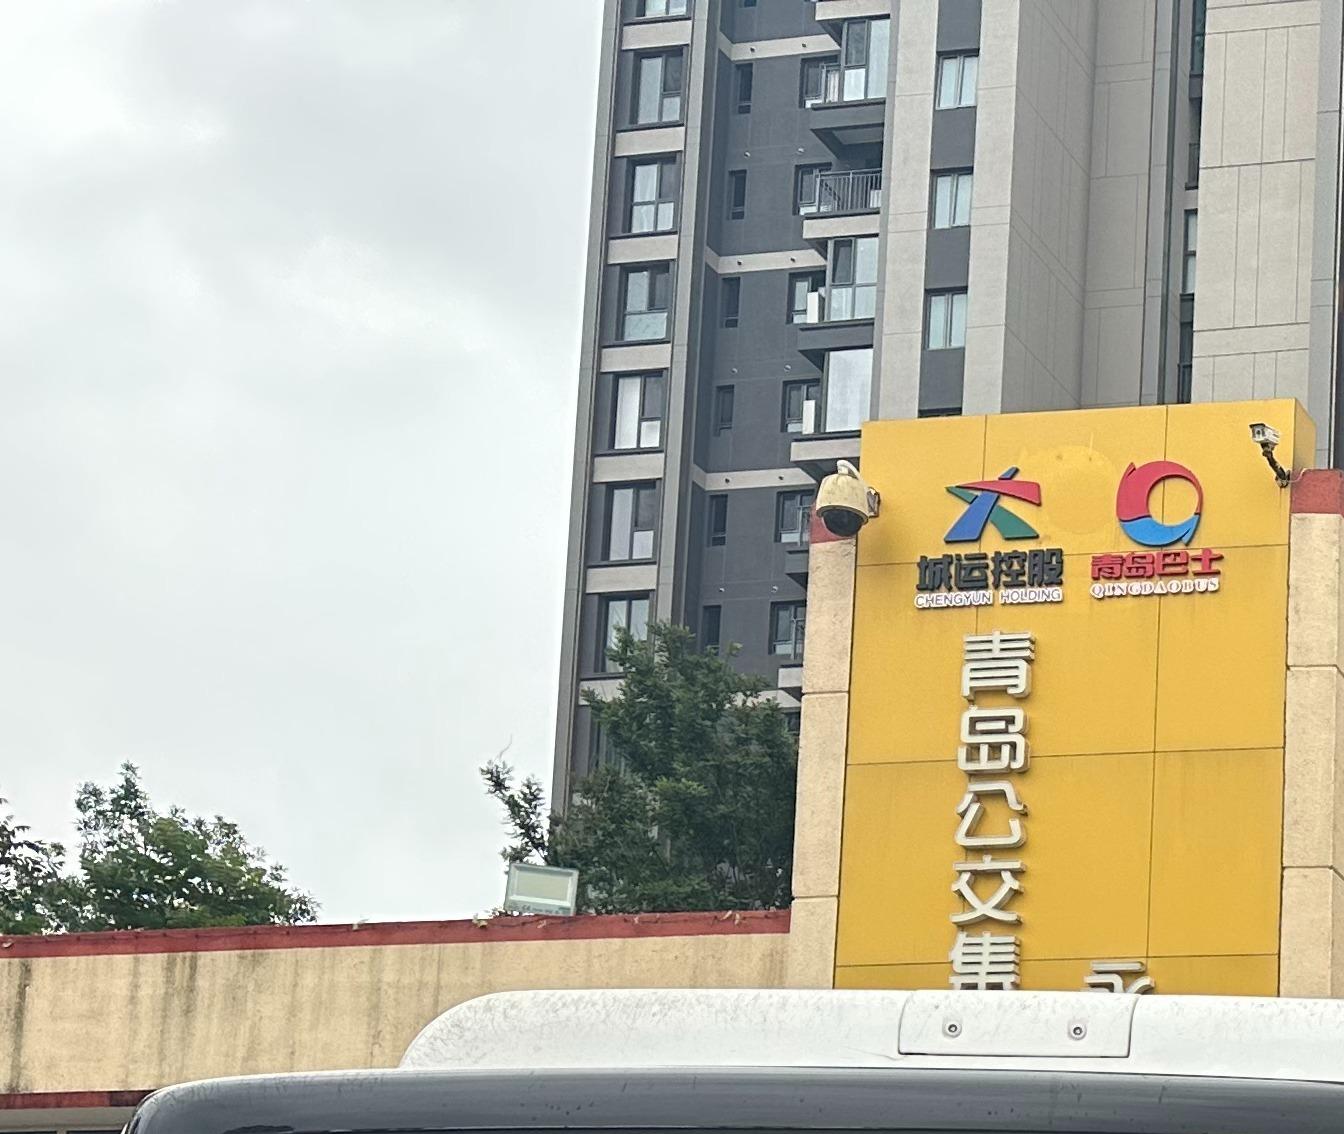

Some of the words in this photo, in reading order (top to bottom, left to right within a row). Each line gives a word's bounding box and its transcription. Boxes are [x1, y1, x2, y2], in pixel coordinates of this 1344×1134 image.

[916, 548, 1063, 590] 城运控股
[1091, 549, 1223, 580] 青岛巴士
[915, 591, 992, 607] CHENGYUN
[1001, 588, 1062, 604] HOLDING
[1090, 579, 1220, 598] QINGDAOBUS
